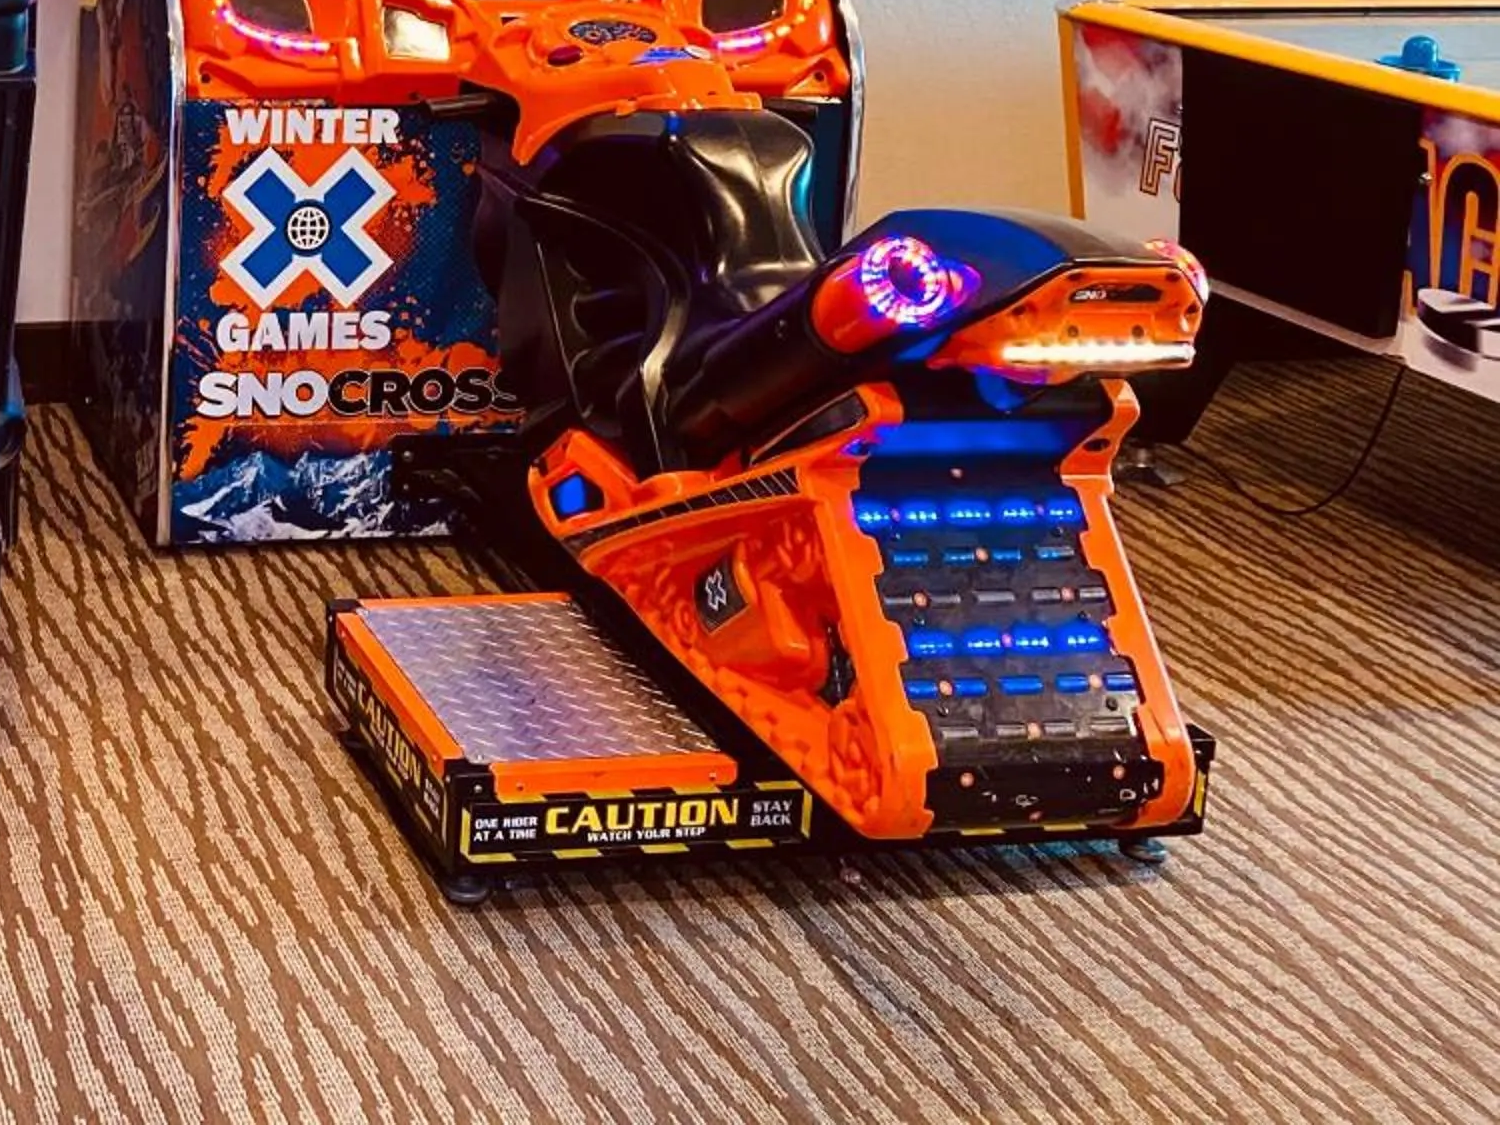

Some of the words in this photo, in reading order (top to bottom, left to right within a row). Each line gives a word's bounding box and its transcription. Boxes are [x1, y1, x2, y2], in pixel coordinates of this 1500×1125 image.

[225, 106, 400, 147] WINTER
[215, 311, 392, 352] GAMES
[752, 799, 793, 814] STAY
[475, 817, 500, 830] ONE
[503, 816, 538, 829] RIDER
[544, 798, 739, 835] CAUTION
[750, 813, 792, 827] BACK
[473, 829, 491, 841] AT
[494, 829, 505, 840] A
[509, 828, 537, 840] TIME
[587, 830, 632, 843] WATCH
[636, 828, 671, 841] YOUR
[675, 826, 707, 839] STEP
